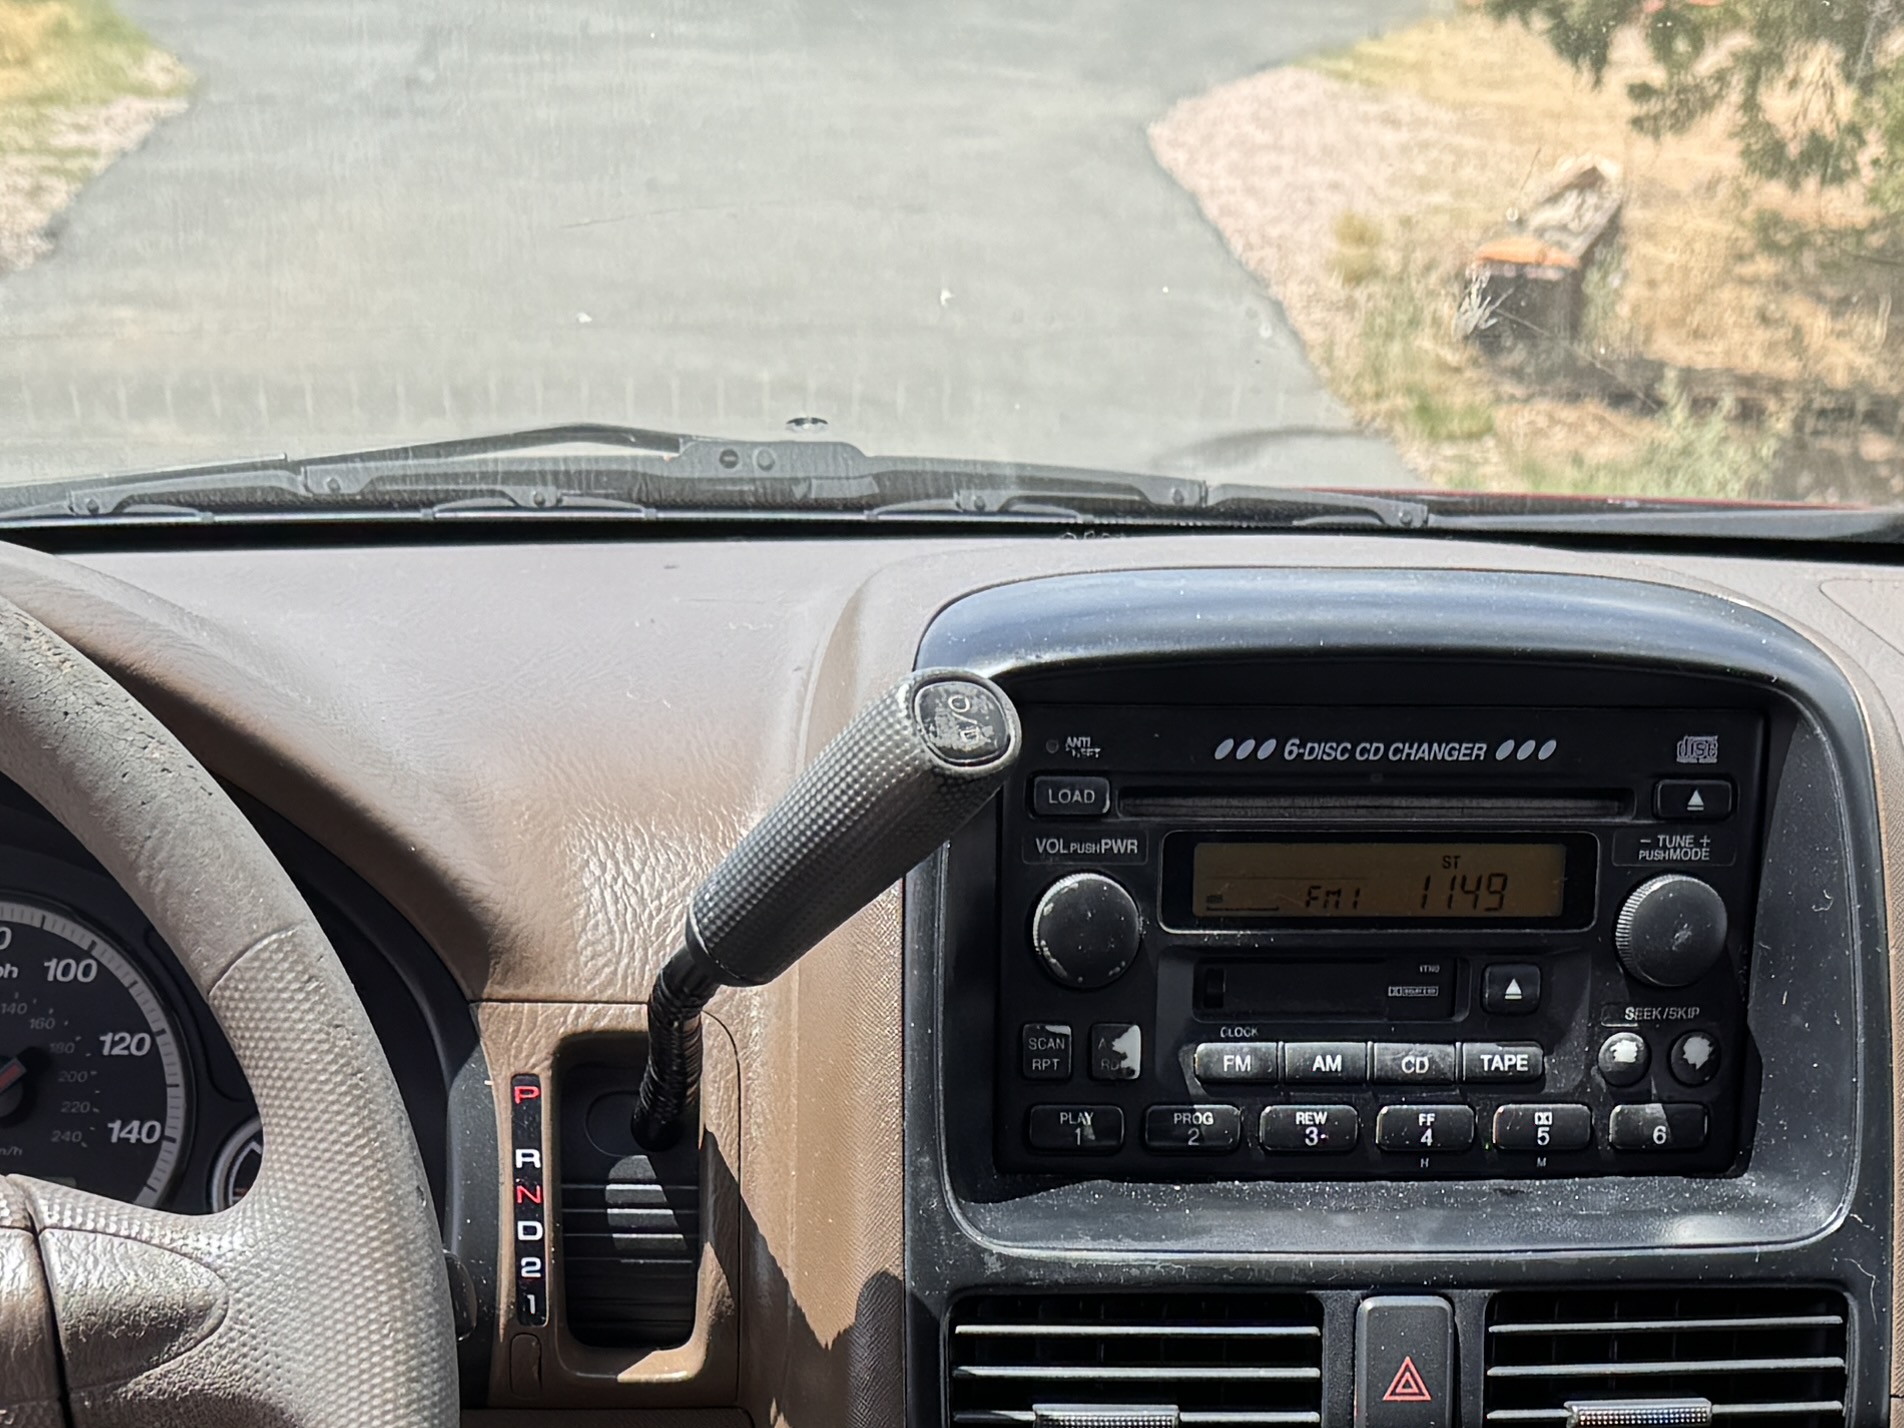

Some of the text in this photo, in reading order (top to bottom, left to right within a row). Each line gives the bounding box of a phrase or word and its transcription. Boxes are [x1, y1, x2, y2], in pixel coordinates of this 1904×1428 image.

[1065, 736, 1091, 747] ANTI
[1065, 748, 1101, 758] EFT
[1284, 738, 1487, 761] 6-DISC CD CHANGER
[1048, 789, 1095, 804] LOAD
[1036, 839, 1138, 854] VOL PUSH PWR
[1657, 835, 1694, 848] TUNE
[1638, 849, 1710, 861] PUSH MODE
[1442, 856, 1461, 870] ST
[43, 958, 97, 982] 100
[0, 1001, 28, 1015] 140
[1625, 1006, 1700, 1021] SEEK/SKIP
[28, 1017, 56, 1030] 160
[1220, 1026, 1259, 1038] CLOCK
[48, 1041, 75, 1055] 180
[99, 1031, 152, 1056] 120
[1028, 1038, 1065, 1050] SCAN
[1032, 1059, 1060, 1071] RPT
[1223, 1055, 1251, 1072] FM
[1312, 1055, 1342, 1072] AM
[1401, 1057, 1429, 1073] CD
[1480, 1055, 1528, 1072] TAPE
[58, 1069, 88, 1083] 200
[514, 1086, 541, 1103] P
[60, 1100, 91, 1114] 220
[1060, 1112, 1094, 1125] PLAY
[1173, 1112, 1214, 1125] PROG
[1296, 1112, 1327, 1125] REW
[1418, 1113, 1435, 1126] FF
[50, 1129, 83, 1143] 240
[107, 1119, 162, 1144] 140
[1074, 1129, 1081, 1145] 1
[1187, 1129, 1200, 1146] 2
[1305, 1129, 1318, 1146] 3
[1420, 1129, 1433, 1146] 4
[1537, 1127, 1550, 1145] 5
[1652, 1126, 1667, 1144] 6
[515, 1149, 541, 1168] R
[1420, 1158, 1429, 1167] H
[1537, 1158, 1546, 1167] M
[516, 1184, 542, 1204] N
[517, 1221, 543, 1240] D
[520, 1257, 542, 1278] 2
[527, 1294, 536, 1314] 1
